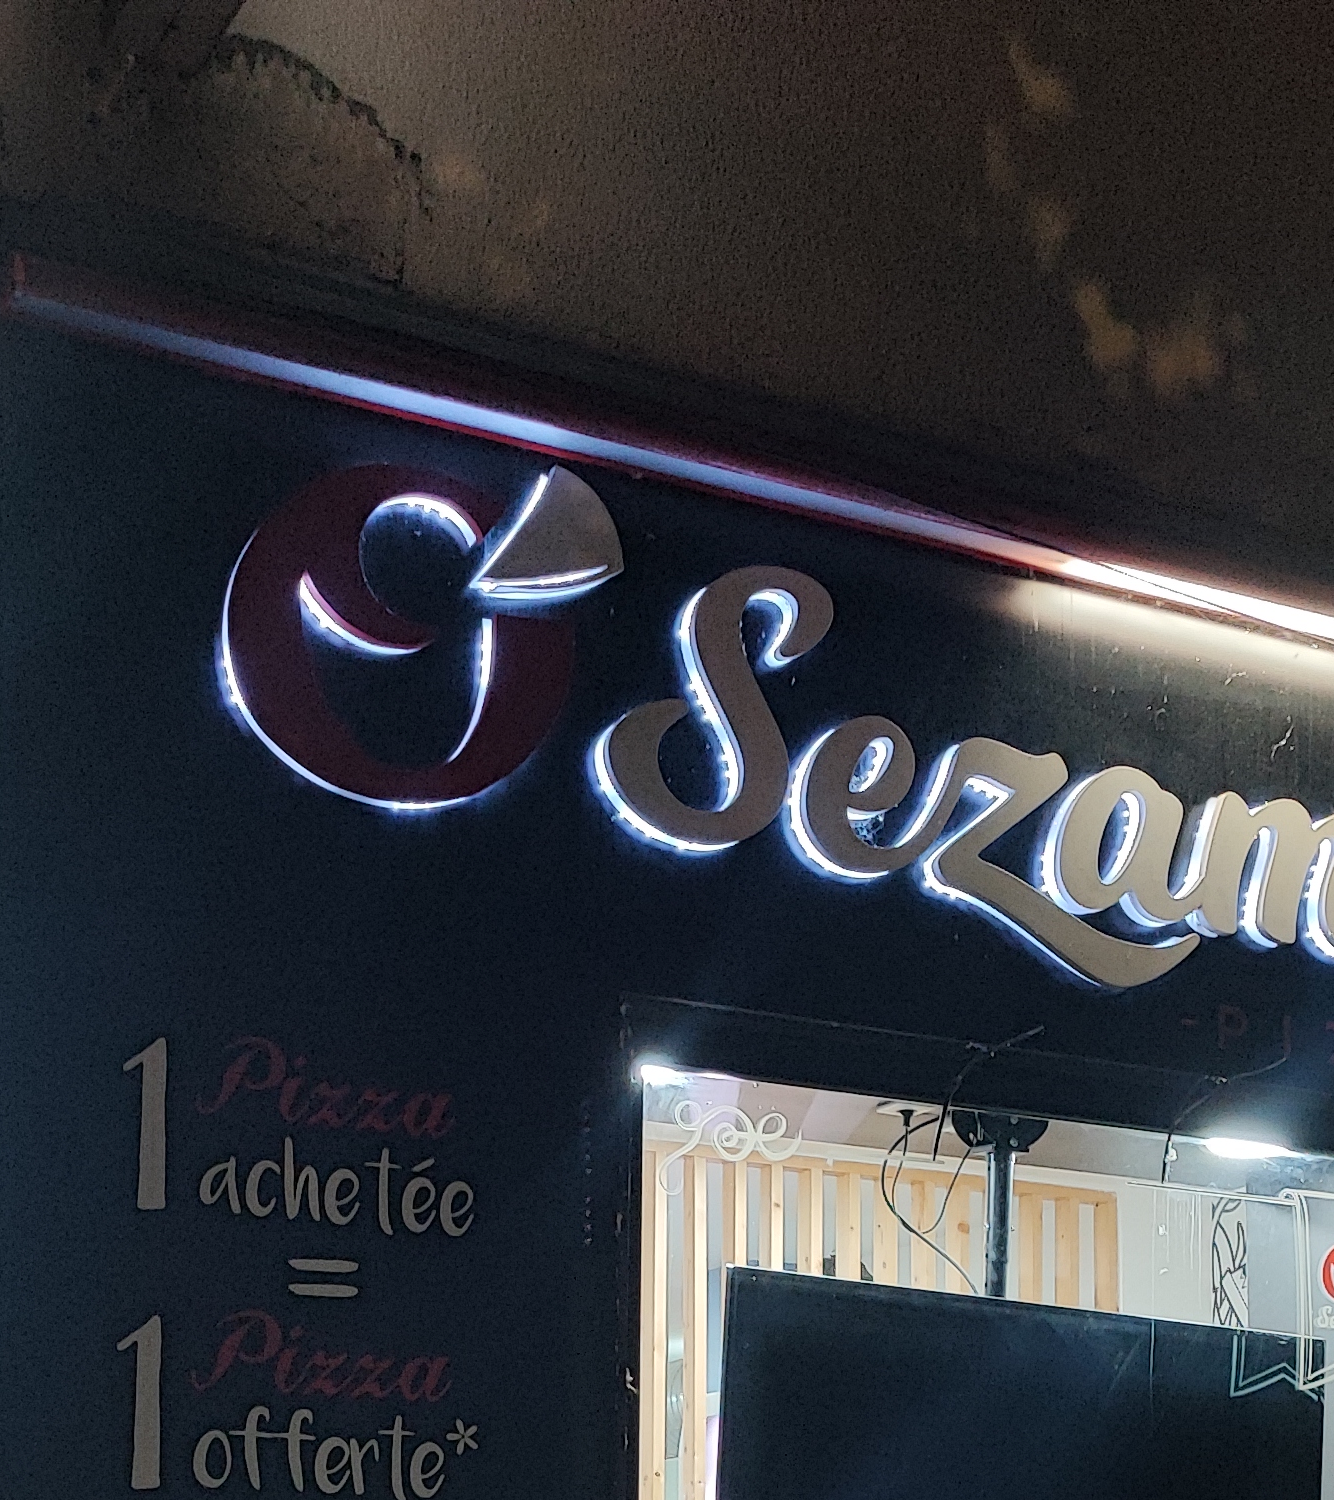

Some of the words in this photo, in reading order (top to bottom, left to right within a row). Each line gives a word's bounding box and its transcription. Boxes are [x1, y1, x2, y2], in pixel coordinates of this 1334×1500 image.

[122, 1037, 166, 1210] 1
[195, 1036, 455, 1138] Pizza
[199, 1136, 475, 1237] achetée
[116, 1314, 161, 1490] 1
[189, 1308, 452, 1401] Pizza
